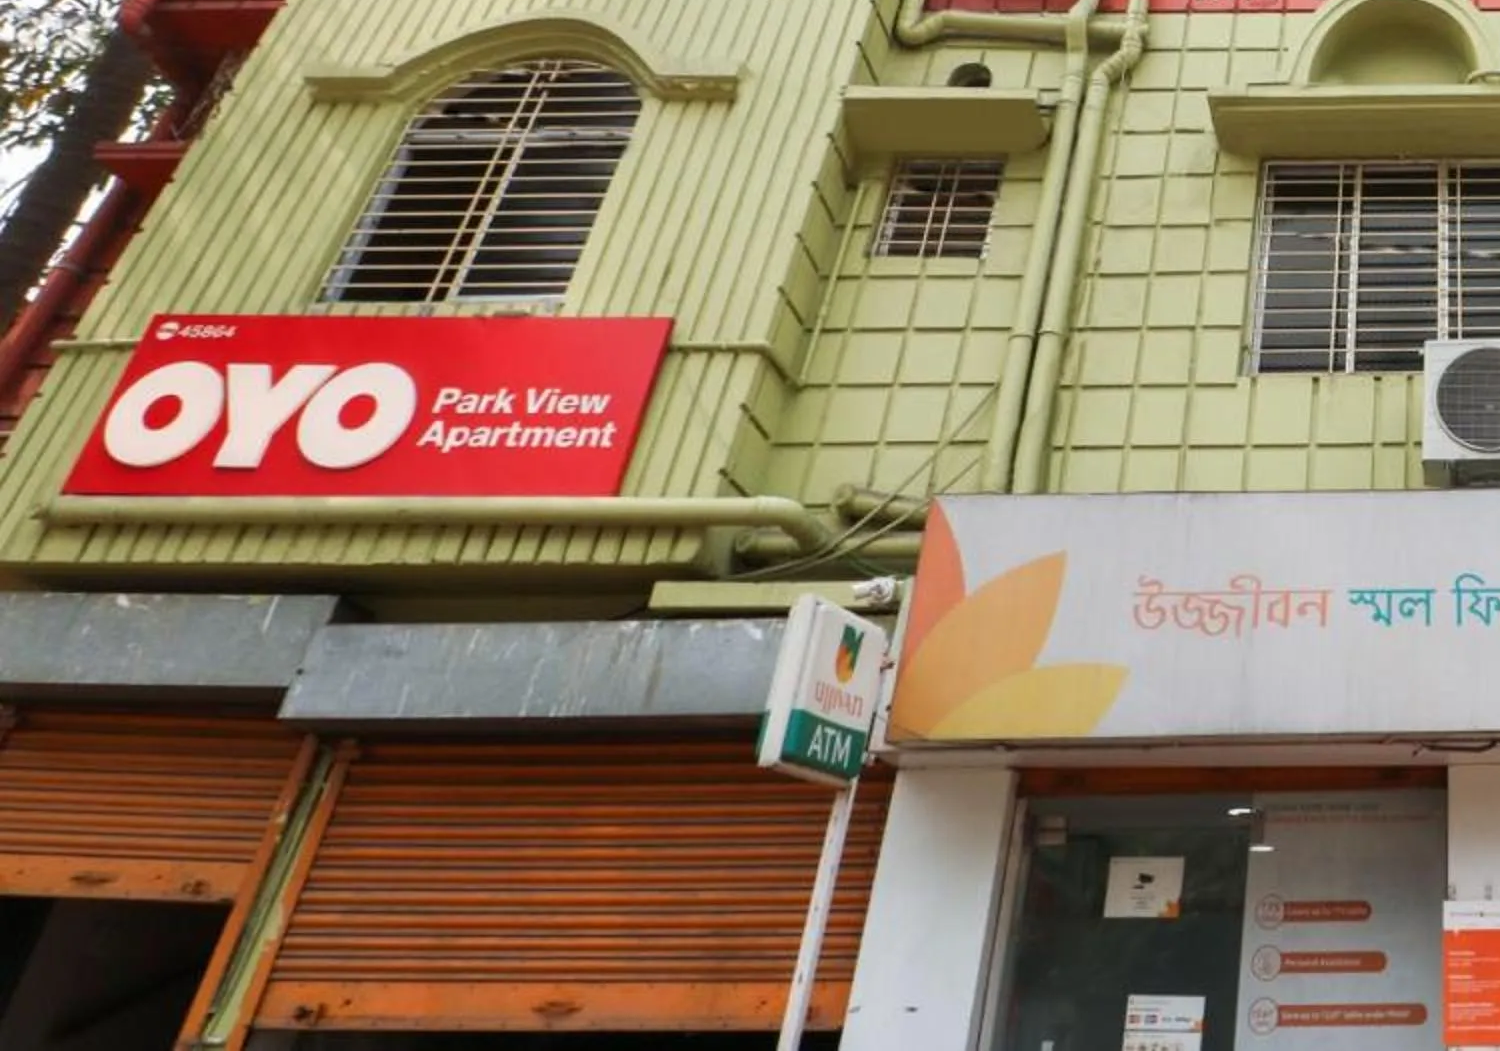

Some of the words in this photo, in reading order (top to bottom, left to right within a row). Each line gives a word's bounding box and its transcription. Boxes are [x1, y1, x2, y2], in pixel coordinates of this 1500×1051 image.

[177, 323, 239, 339] 45864
[103, 360, 417, 470] OYO
[431, 387, 515, 415] Park
[525, 387, 611, 415] View
[416, 419, 617, 453] Apartment
[807, 723, 853, 770] ATM
